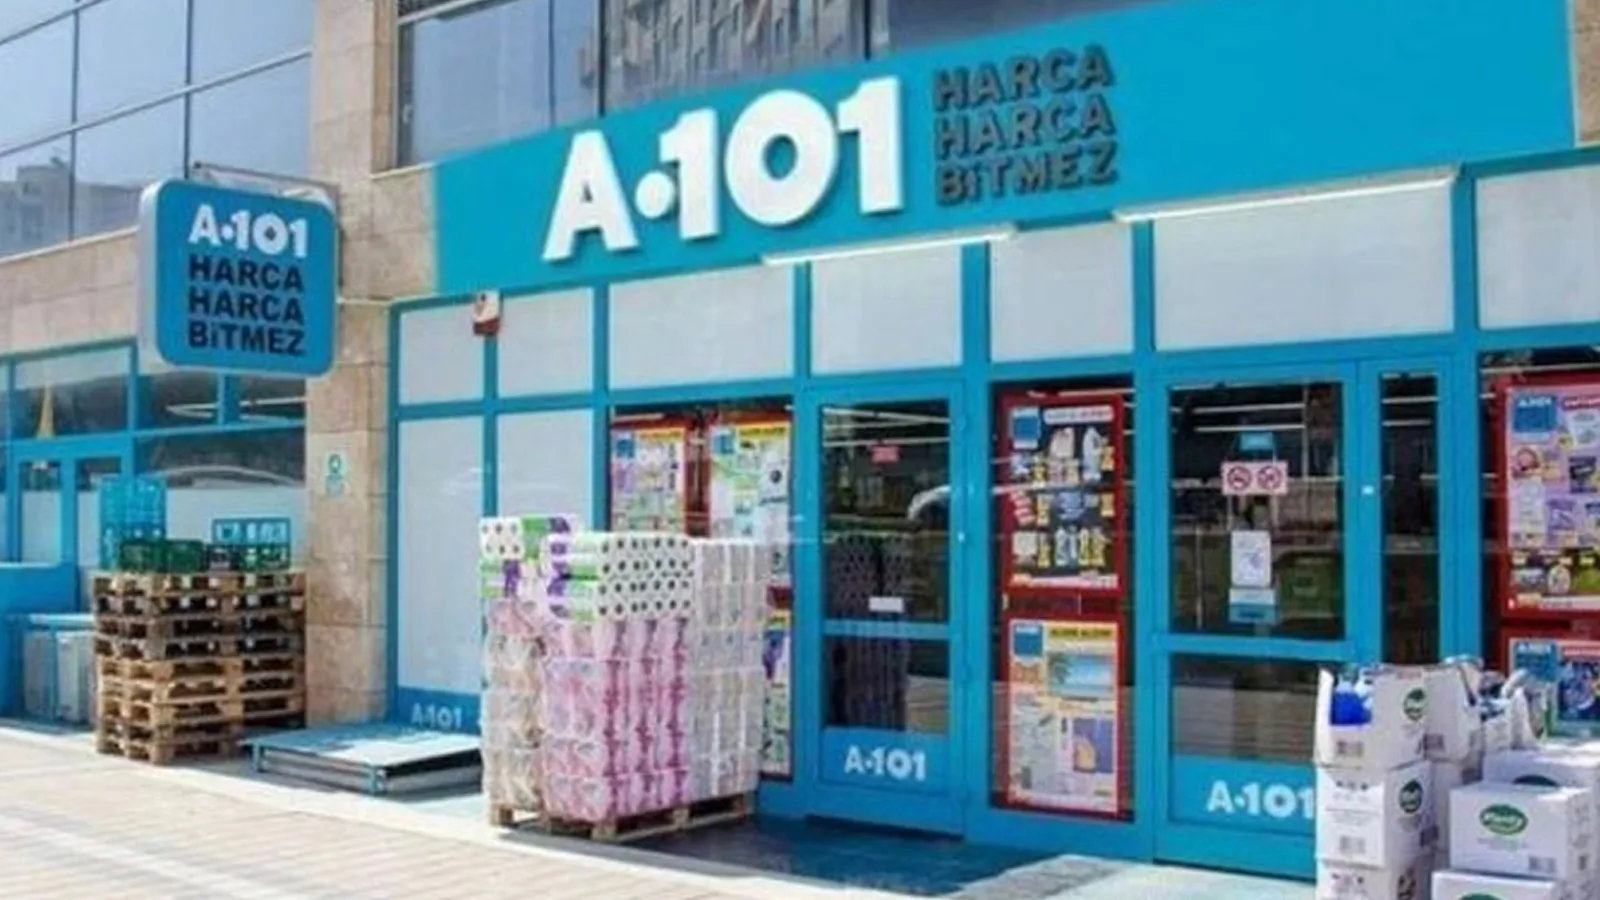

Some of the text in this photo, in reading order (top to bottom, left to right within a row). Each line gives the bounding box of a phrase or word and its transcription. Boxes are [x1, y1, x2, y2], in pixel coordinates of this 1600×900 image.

[934, 44, 1115, 112] HARCA
[935, 93, 1116, 160] HARCA
[189, 254, 305, 293] HARCA
[189, 286, 305, 326] HARCA
